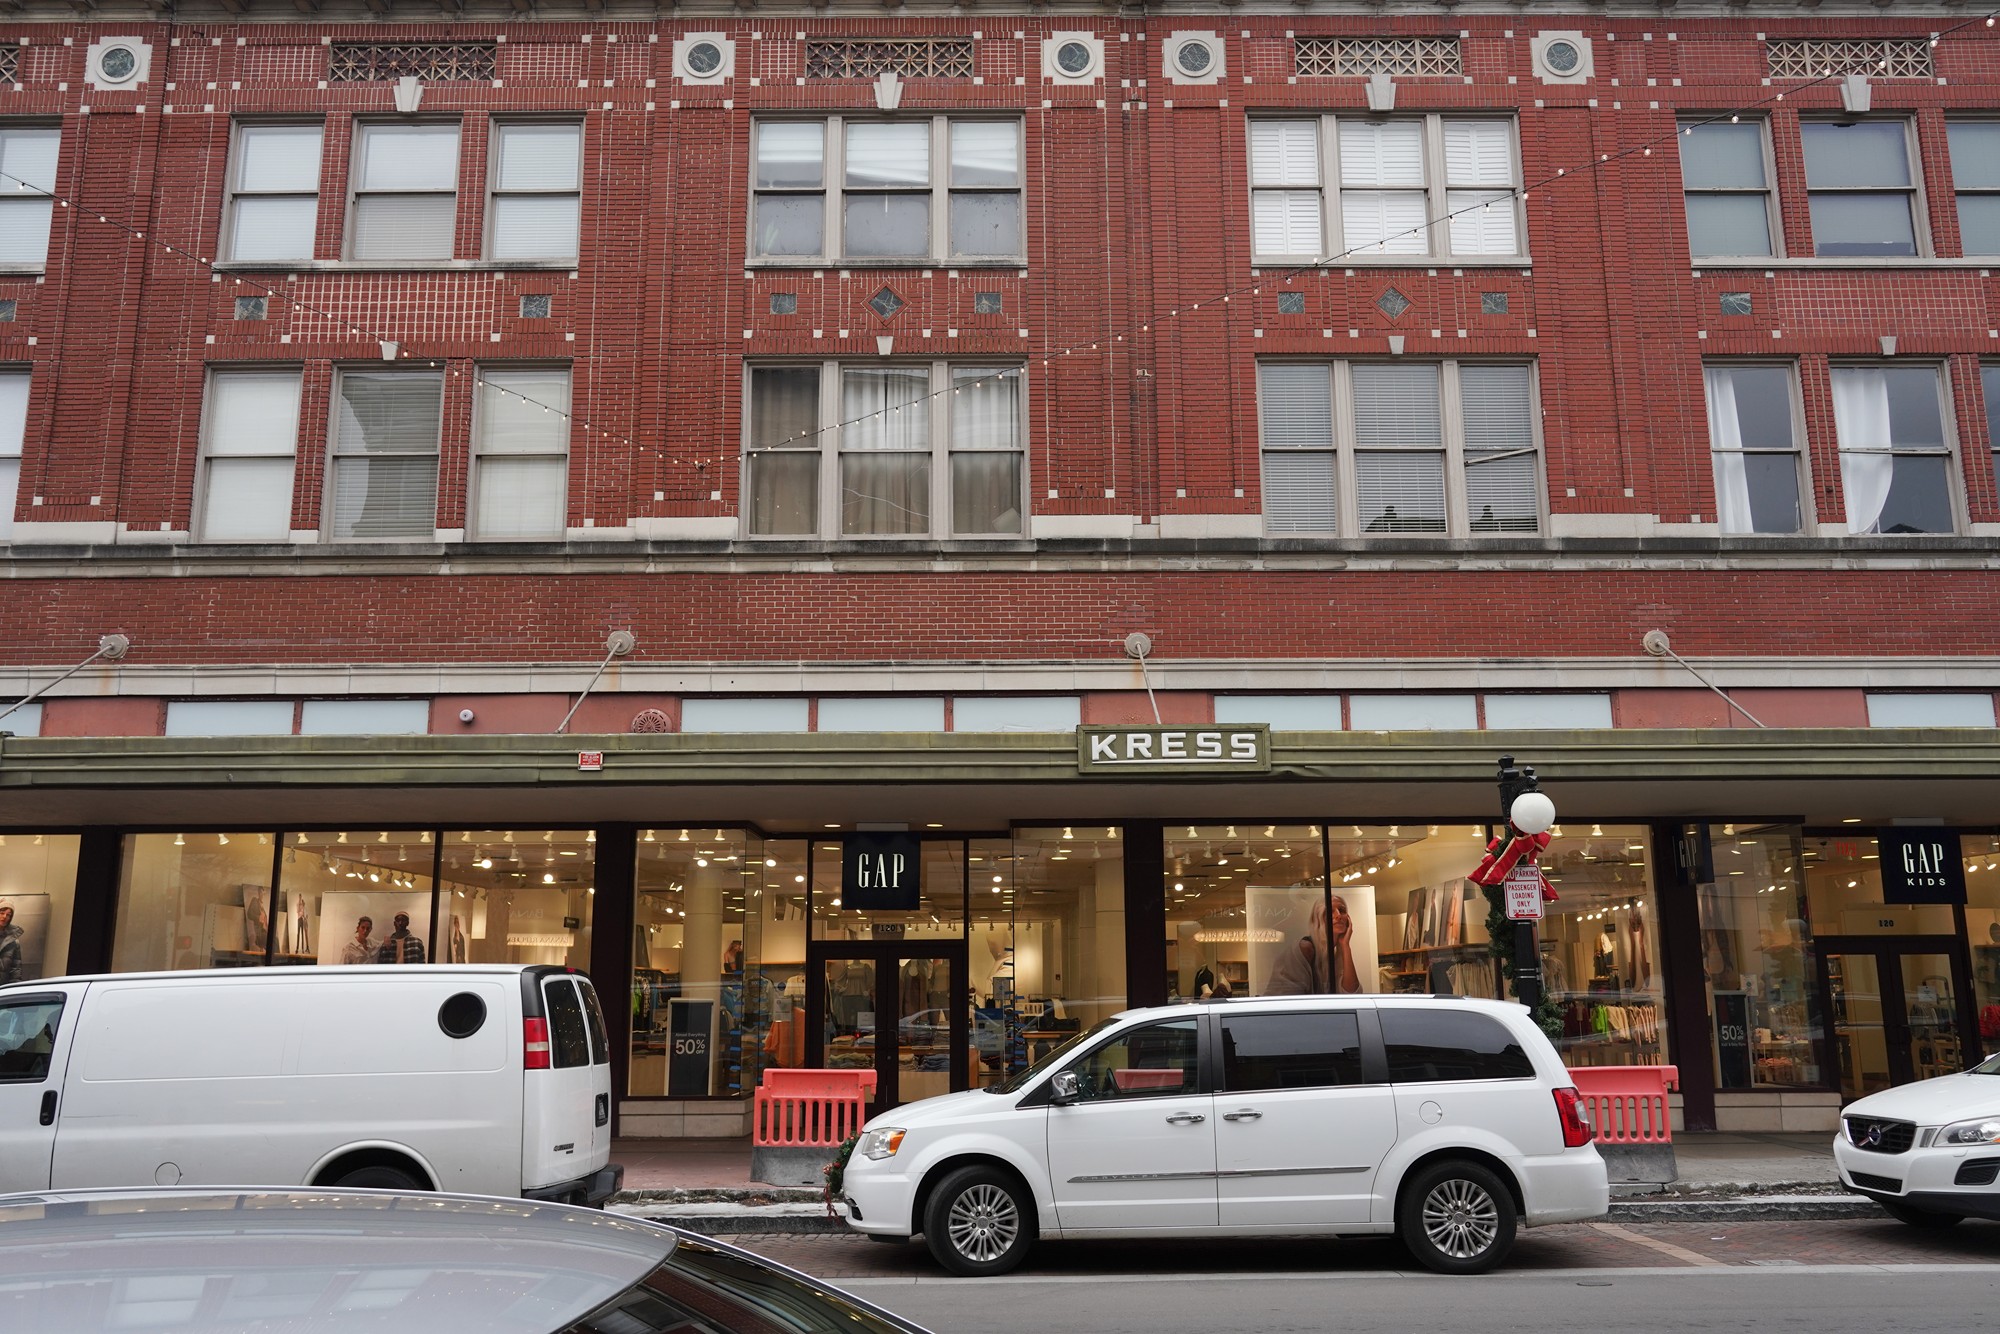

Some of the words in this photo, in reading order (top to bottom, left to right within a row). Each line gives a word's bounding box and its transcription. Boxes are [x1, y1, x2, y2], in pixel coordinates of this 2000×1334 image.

[1091, 732, 1257, 761] KRESS
[1902, 843, 1944, 874] GAP
[858, 853, 905, 888] GAP
[1515, 870, 1538, 878] PARKING
[1907, 878, 1946, 886] KIDS
[880, 924, 896, 932] 120
[1721, 1025, 1744, 1040] 50%
[676, 1039, 706, 1054] 50%
